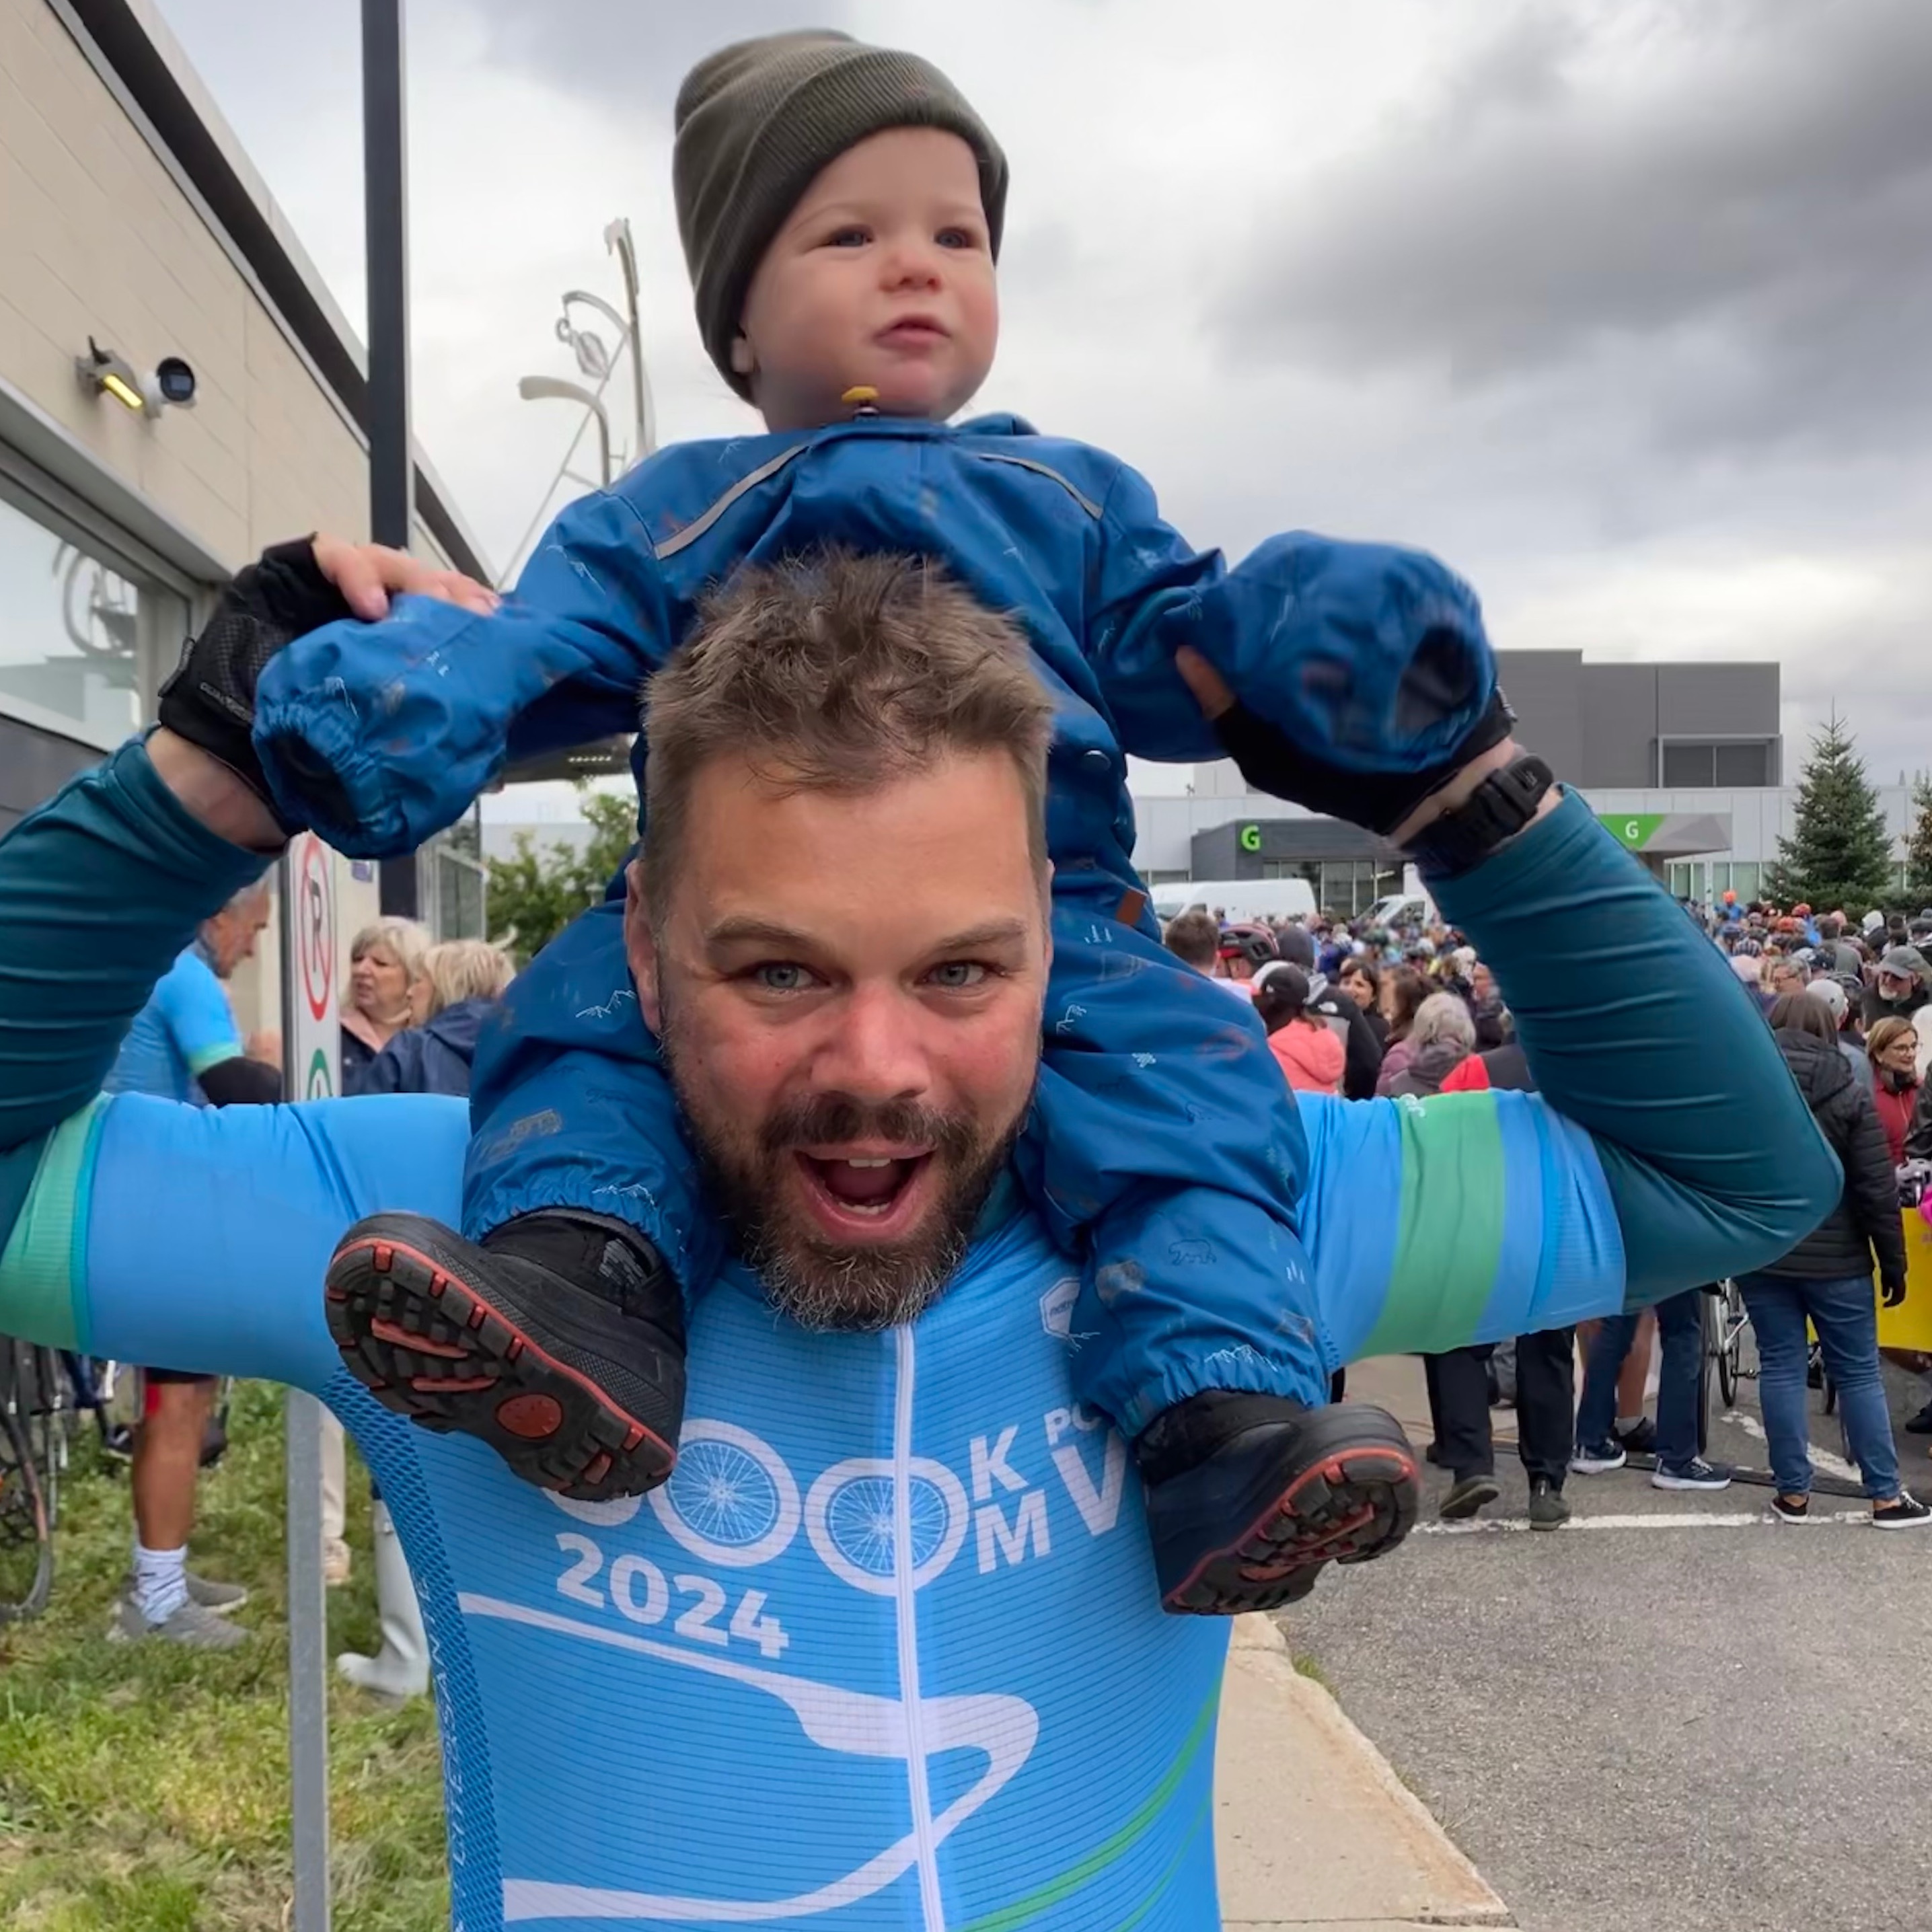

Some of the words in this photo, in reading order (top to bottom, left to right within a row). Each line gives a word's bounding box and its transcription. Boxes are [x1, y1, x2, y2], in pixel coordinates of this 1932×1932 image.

[1242, 825, 1260, 851] G
[1625, 820, 1639, 839] G
[555, 1532, 789, 1659] 2024
